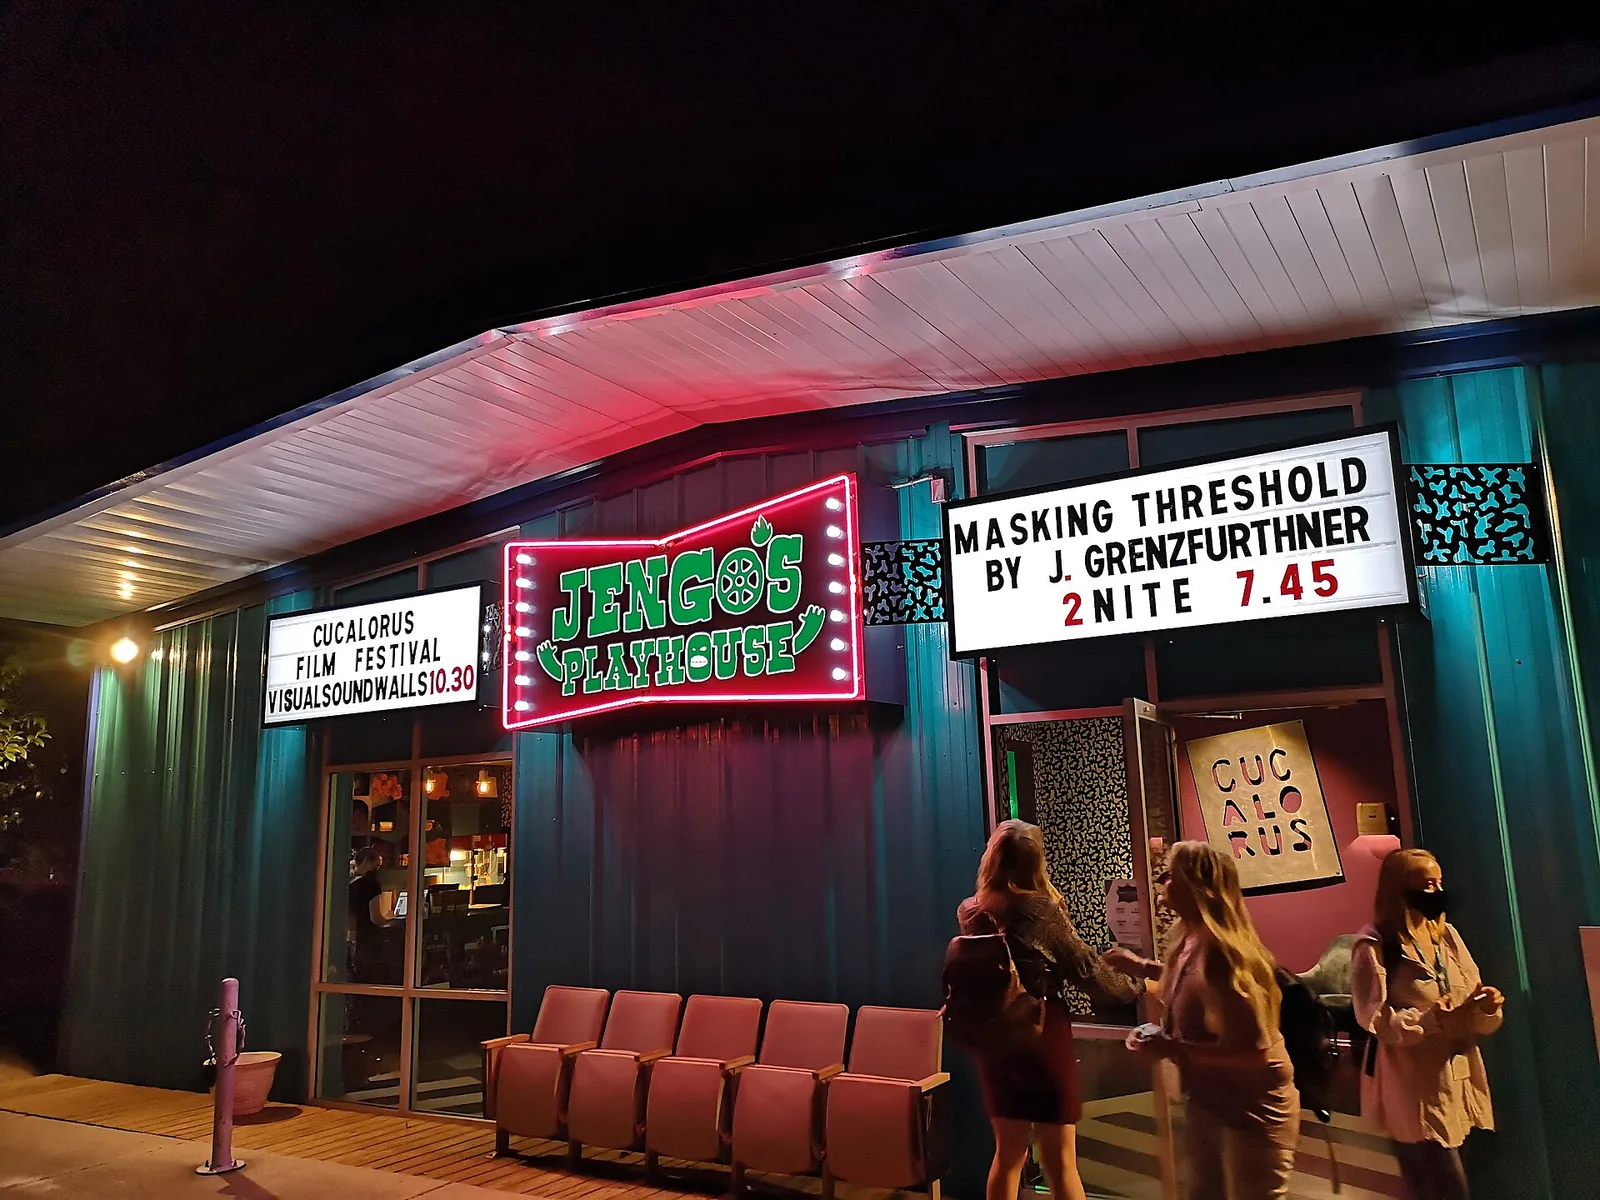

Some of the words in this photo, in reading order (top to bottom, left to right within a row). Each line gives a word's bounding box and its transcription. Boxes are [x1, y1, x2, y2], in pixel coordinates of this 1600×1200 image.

[954, 500, 1113, 555] MASKING
[1132, 457, 1367, 527] THRESHOLD
[986, 556, 1021, 592] BY
[1048, 550, 1072, 584] J.
[1085, 506, 1370, 578] GRENZFURTHNER
[1236, 558, 1339, 607] 7.45
[313, 610, 414, 647] CUCALORUS
[296, 652, 336, 680] FILM
[355, 637, 441, 672] FESTIVAL
[561, 621, 795, 696] PLAYHOUSE
[1212, 749, 1291, 793] CUC
[1223, 785, 1303, 827] ALO
[1228, 818, 1312, 860] RUS
